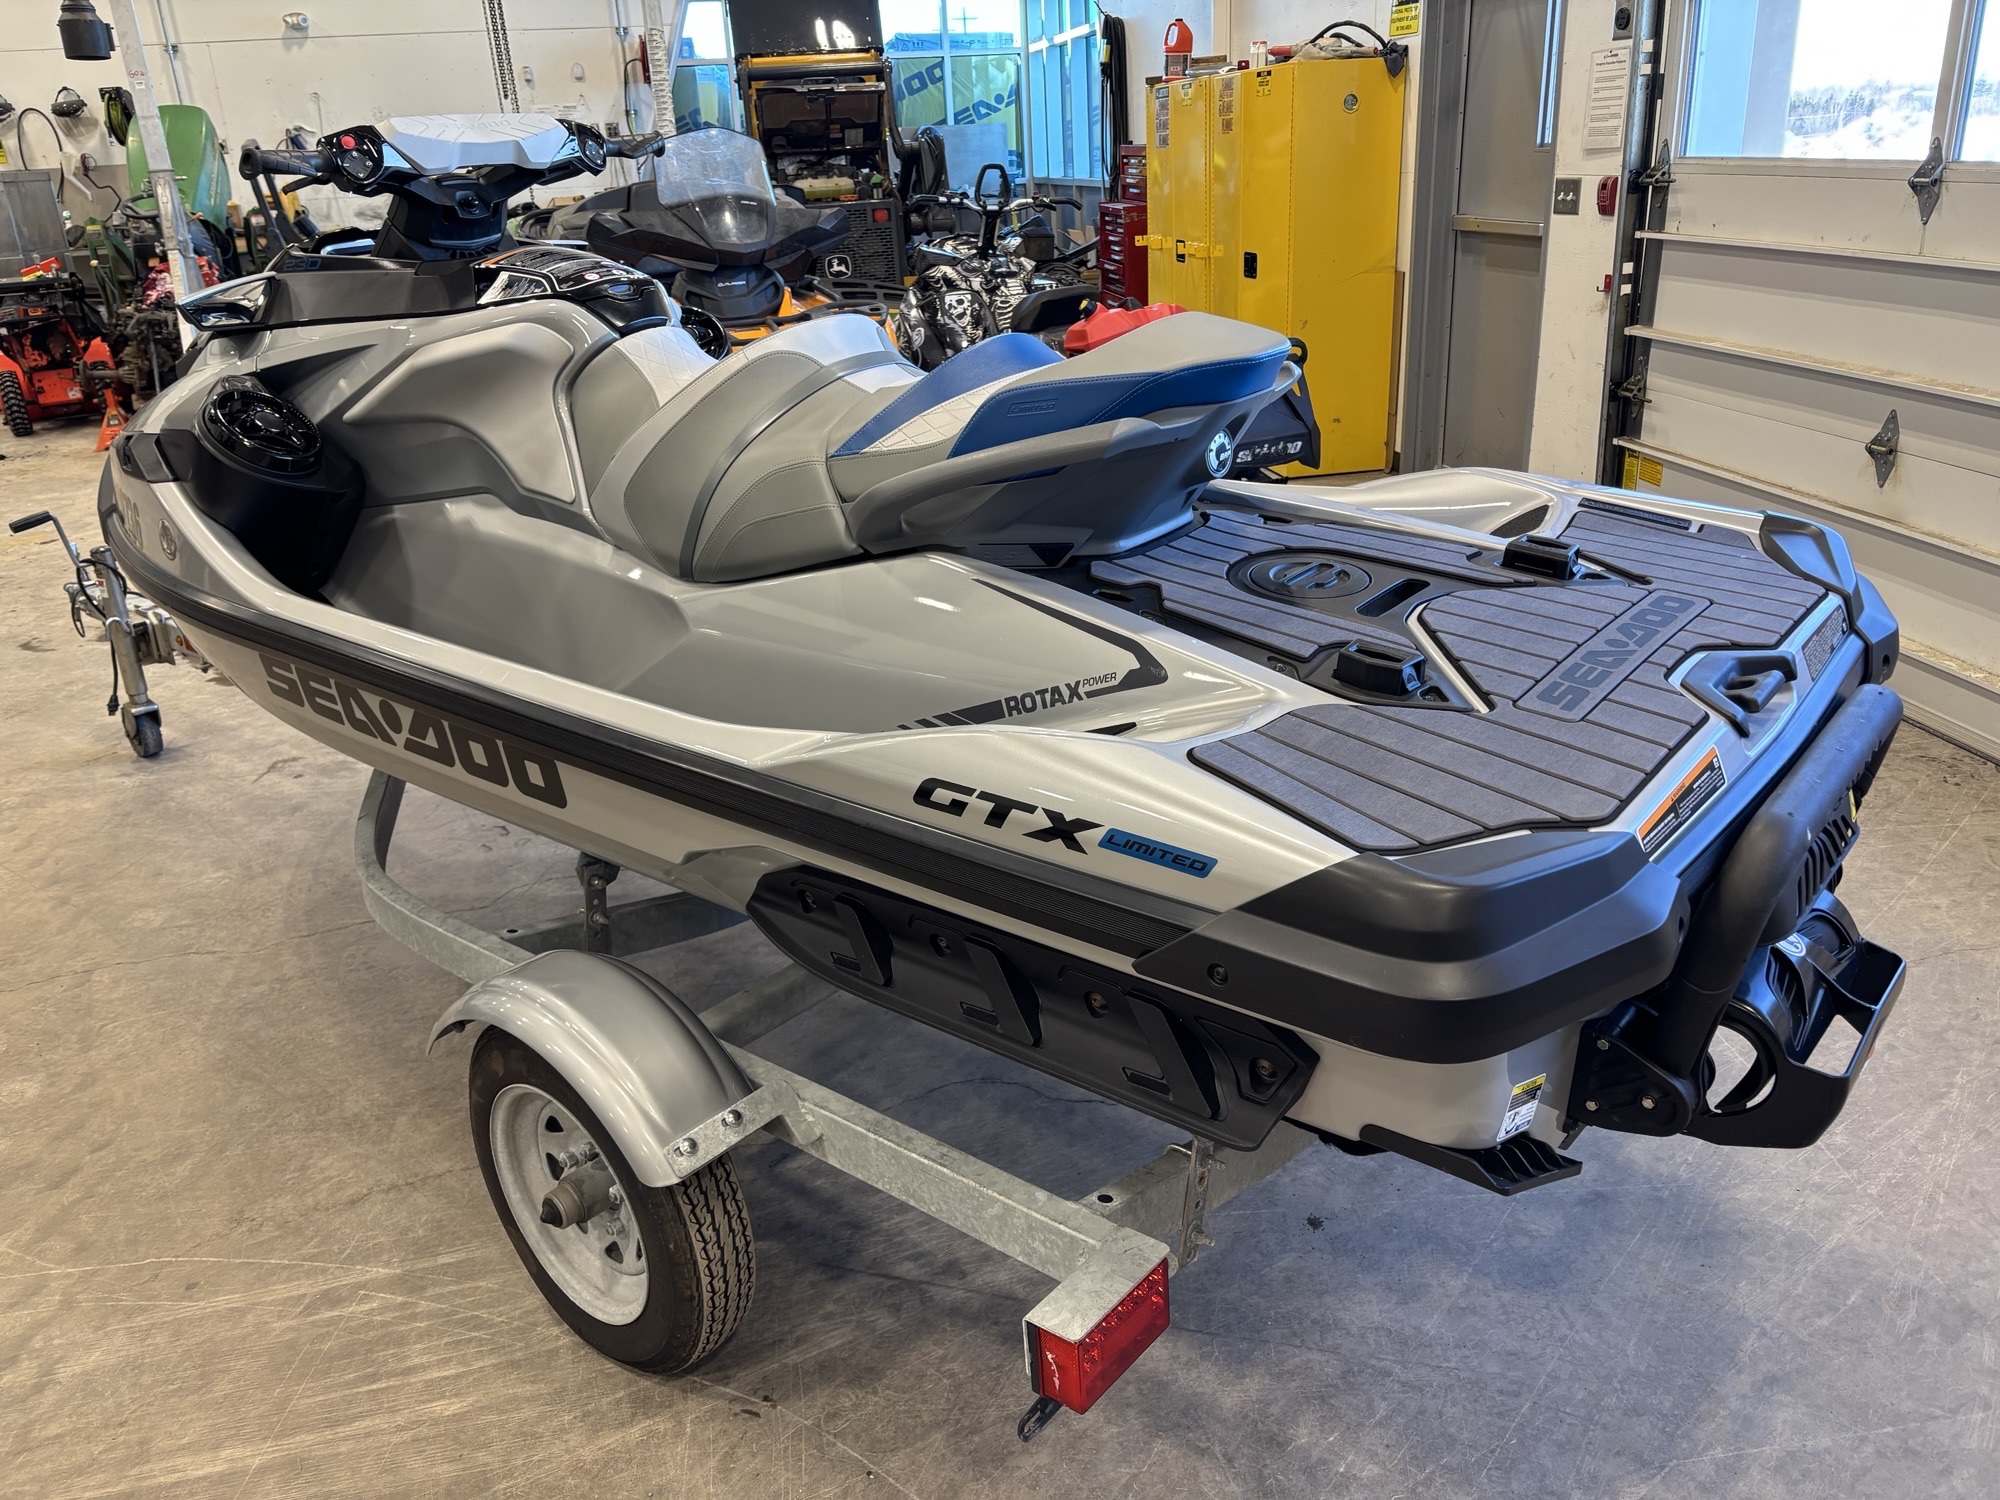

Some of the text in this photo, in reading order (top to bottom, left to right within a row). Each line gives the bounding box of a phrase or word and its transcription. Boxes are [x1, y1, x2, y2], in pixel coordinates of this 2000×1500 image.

[283, 257, 322, 271] 230
[1003, 672, 1118, 718] ROTAX POWER
[912, 777, 1209, 873] GTX LIMITED
